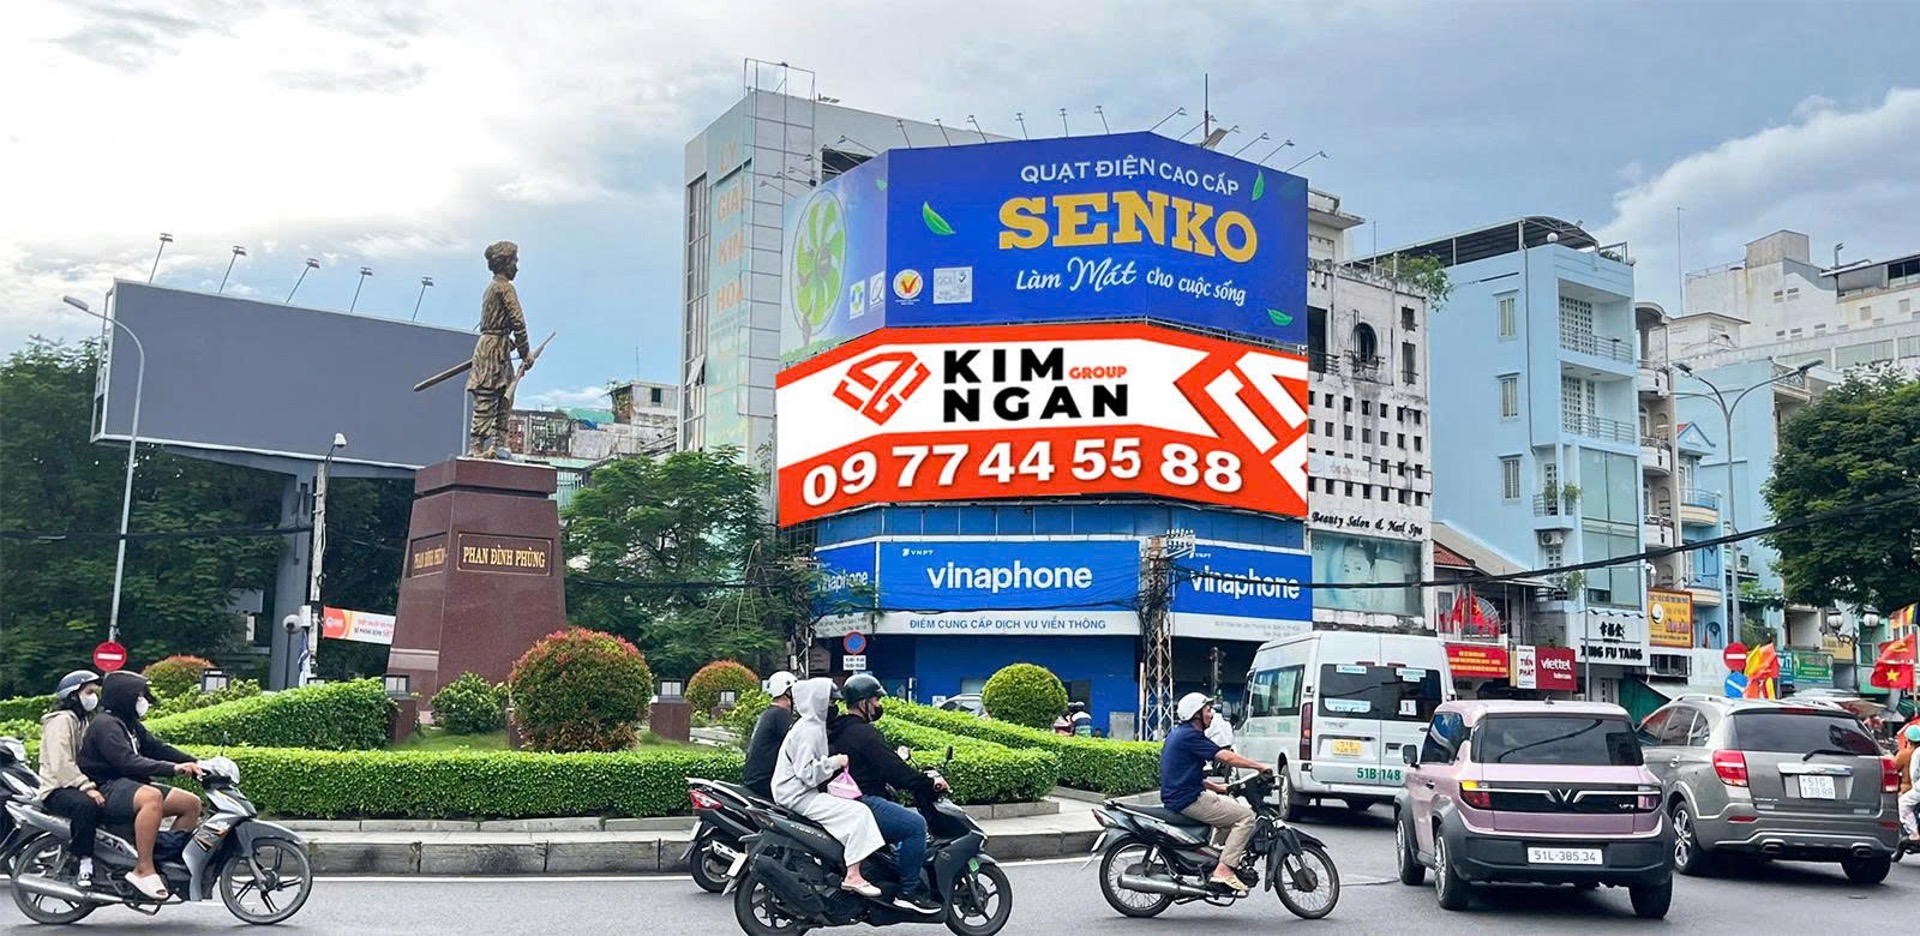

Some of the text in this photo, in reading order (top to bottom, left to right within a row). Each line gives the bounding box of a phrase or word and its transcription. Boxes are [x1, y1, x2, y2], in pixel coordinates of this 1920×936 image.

[1020, 154, 1239, 196] QUẠT ĐIỆN CAO CẤP
[998, 190, 1258, 264] SENKO
[1016, 256, 1246, 307] Làm Mát cho cuộc sống
[942, 347, 1064, 385] KIM
[1068, 365, 1128, 380] GROUP
[942, 384, 1129, 423] NGAN
[802, 438, 1243, 507] 09 77 44 55 88
[1311, 511, 1344, 529] Beauty
[1346, 515, 1371, 529] Salon
[1408, 523, 1423, 537] Spa
[462, 544, 546, 568] PHAN ĐÌNH PHÙNG
[926, 559, 1093, 593] vinaphone
[1190, 564, 1301, 599] vinaphone
[937, 619, 969, 629] CUNG
[970, 615, 993, 629] CẤP
[1068, 616, 1106, 630] THÔNG
[1540, 658, 1572, 671] viettel
[1605, 646, 1617, 659] FU
[1619, 647, 1643, 660] TANG
[1533, 849, 1597, 862] 51L-385.34
